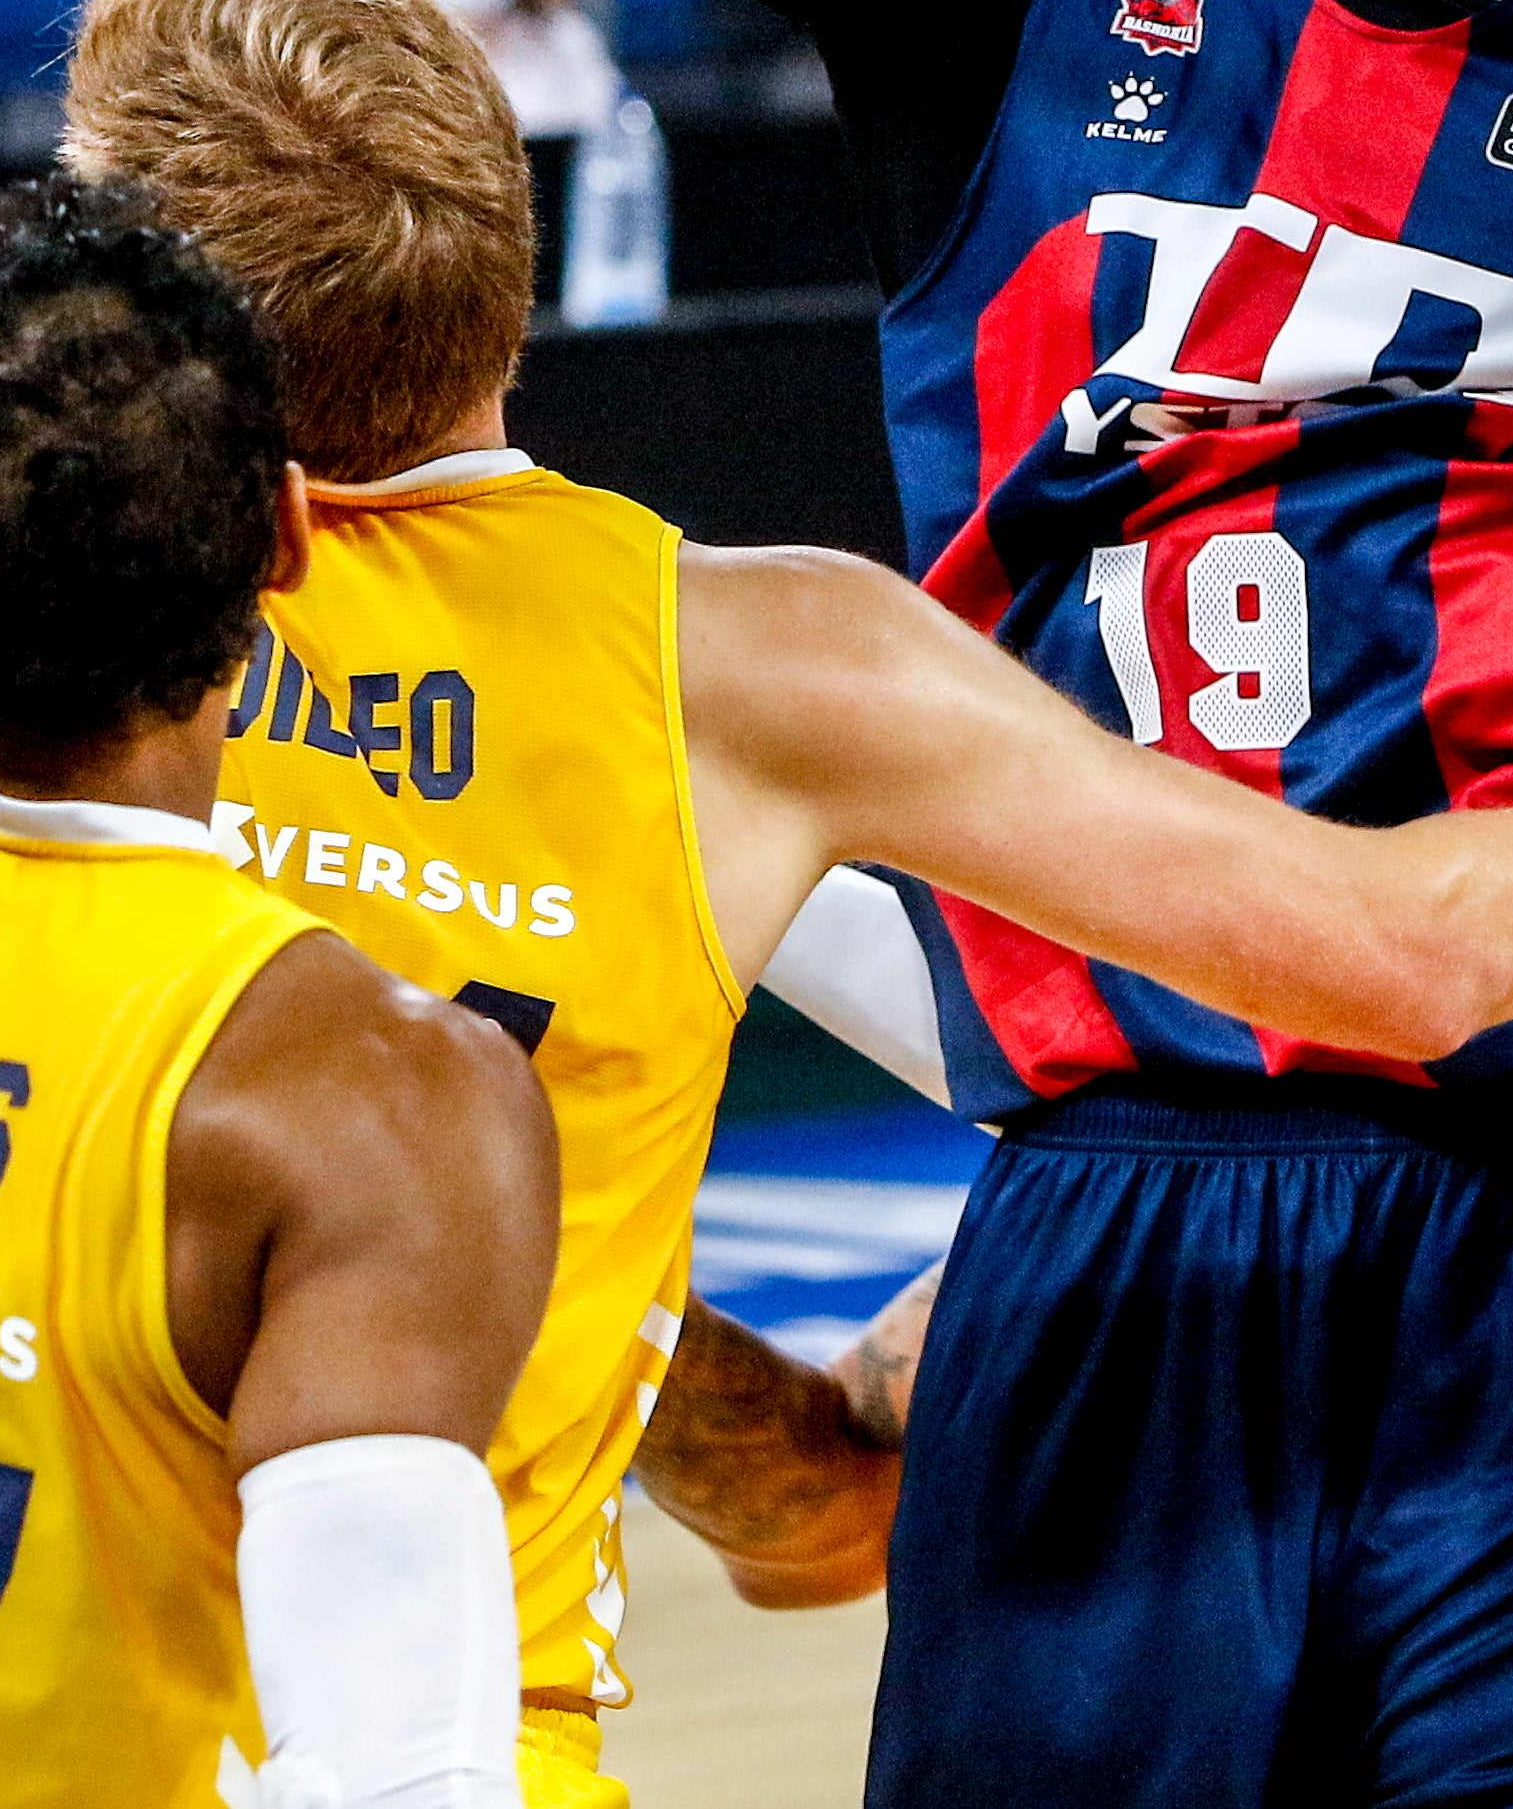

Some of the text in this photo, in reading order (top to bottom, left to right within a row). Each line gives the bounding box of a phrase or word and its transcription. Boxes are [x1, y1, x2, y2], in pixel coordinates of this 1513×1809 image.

[1085, 121, 1168, 144] KELME
[1082, 531, 1312, 751] 19
[254, 822, 576, 938] VERSUS
